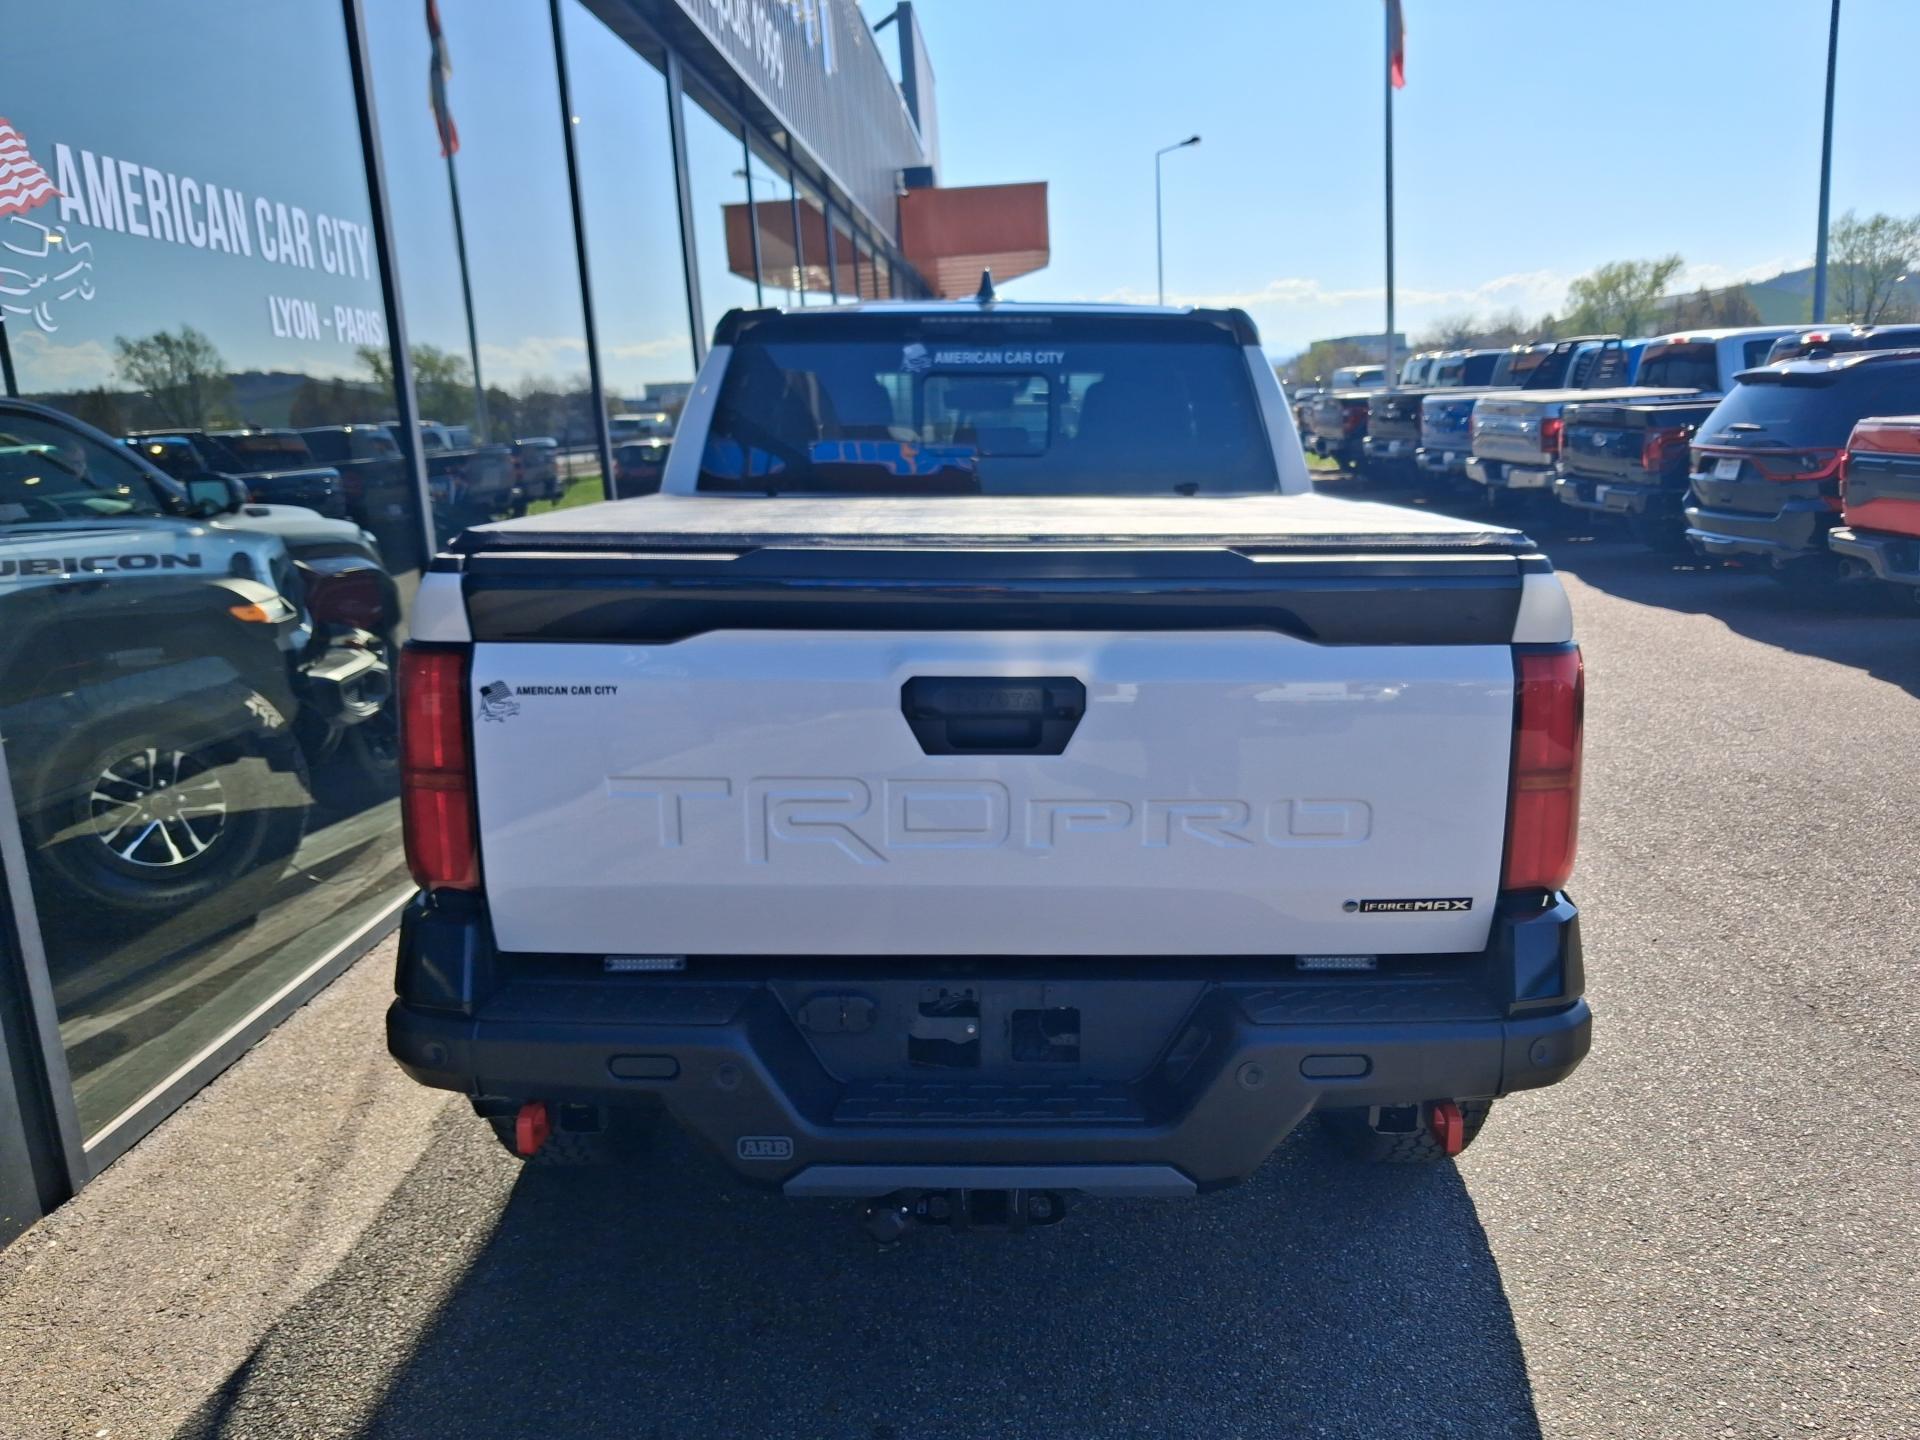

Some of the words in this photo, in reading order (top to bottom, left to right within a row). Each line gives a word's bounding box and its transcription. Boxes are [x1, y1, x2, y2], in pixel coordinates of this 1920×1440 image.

[54, 143, 252, 257] AMERICAN
[254, 196, 315, 269] CAR
[316, 213, 372, 280] CITY
[268, 295, 321, 341] LYON
[334, 305, 384, 347] PARIS
[934, 352, 1002, 364] AMERICAN
[1004, 352, 1032, 364] CAR
[1035, 352, 1065, 364] CITY
[516, 686, 568, 696] AMERICAN
[571, 686, 592, 696] CAR
[594, 686, 618, 696] CITY
[603, 776, 1011, 865] TRD
[1024, 798, 1375, 848] PRO
[743, 1140, 789, 1156] ARB
